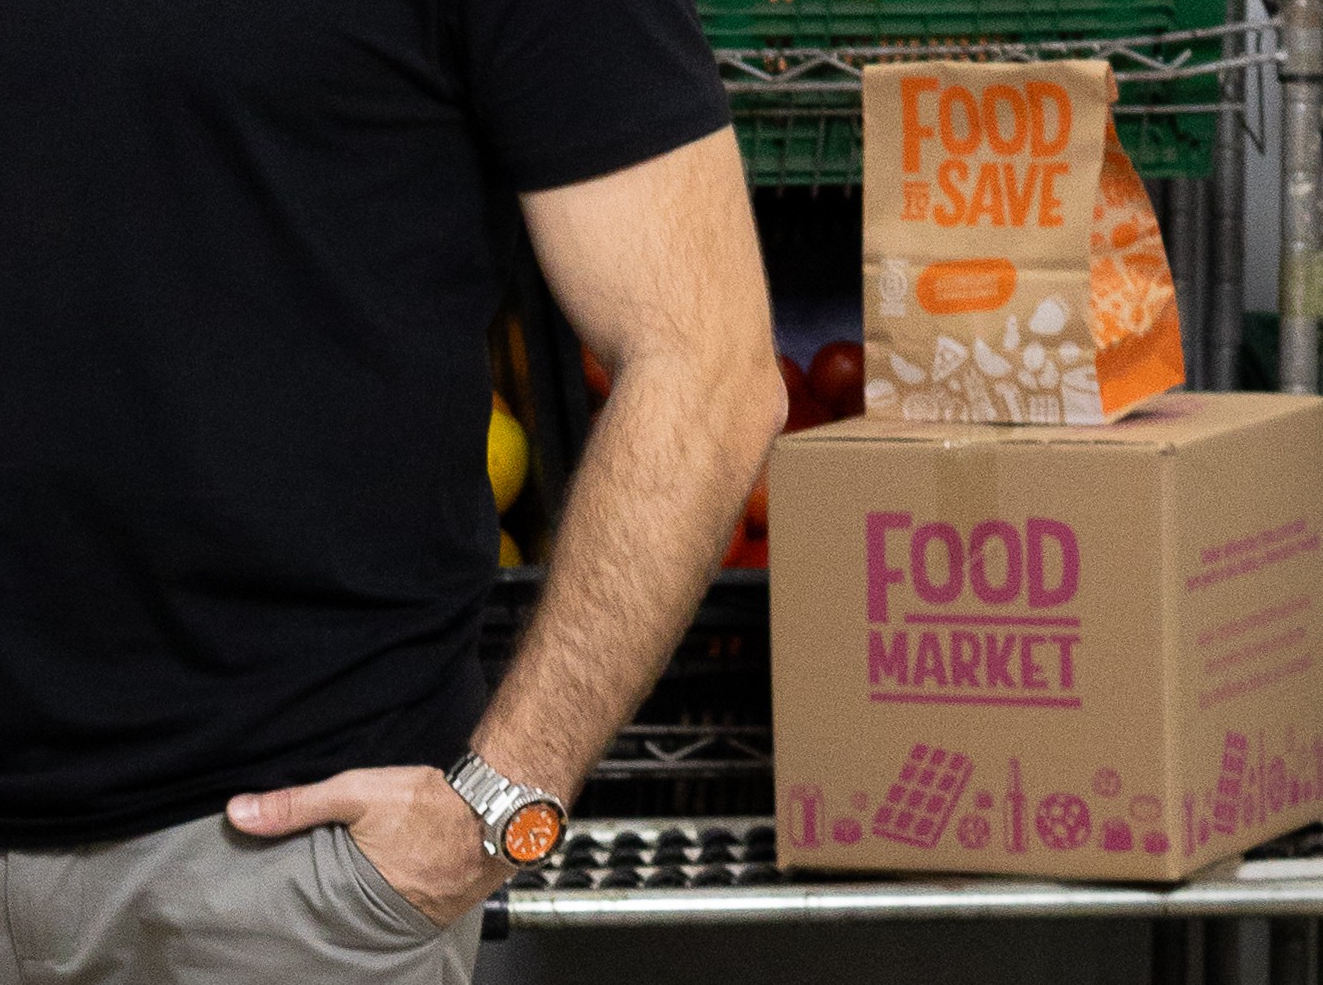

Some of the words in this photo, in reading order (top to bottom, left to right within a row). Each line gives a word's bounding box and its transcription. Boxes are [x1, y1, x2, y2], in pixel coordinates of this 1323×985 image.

[900, 76, 1073, 174] FOOD
[932, 158, 1071, 229] SAVE
[865, 511, 1081, 623] FOOD
[868, 629, 1081, 690] MARKET
